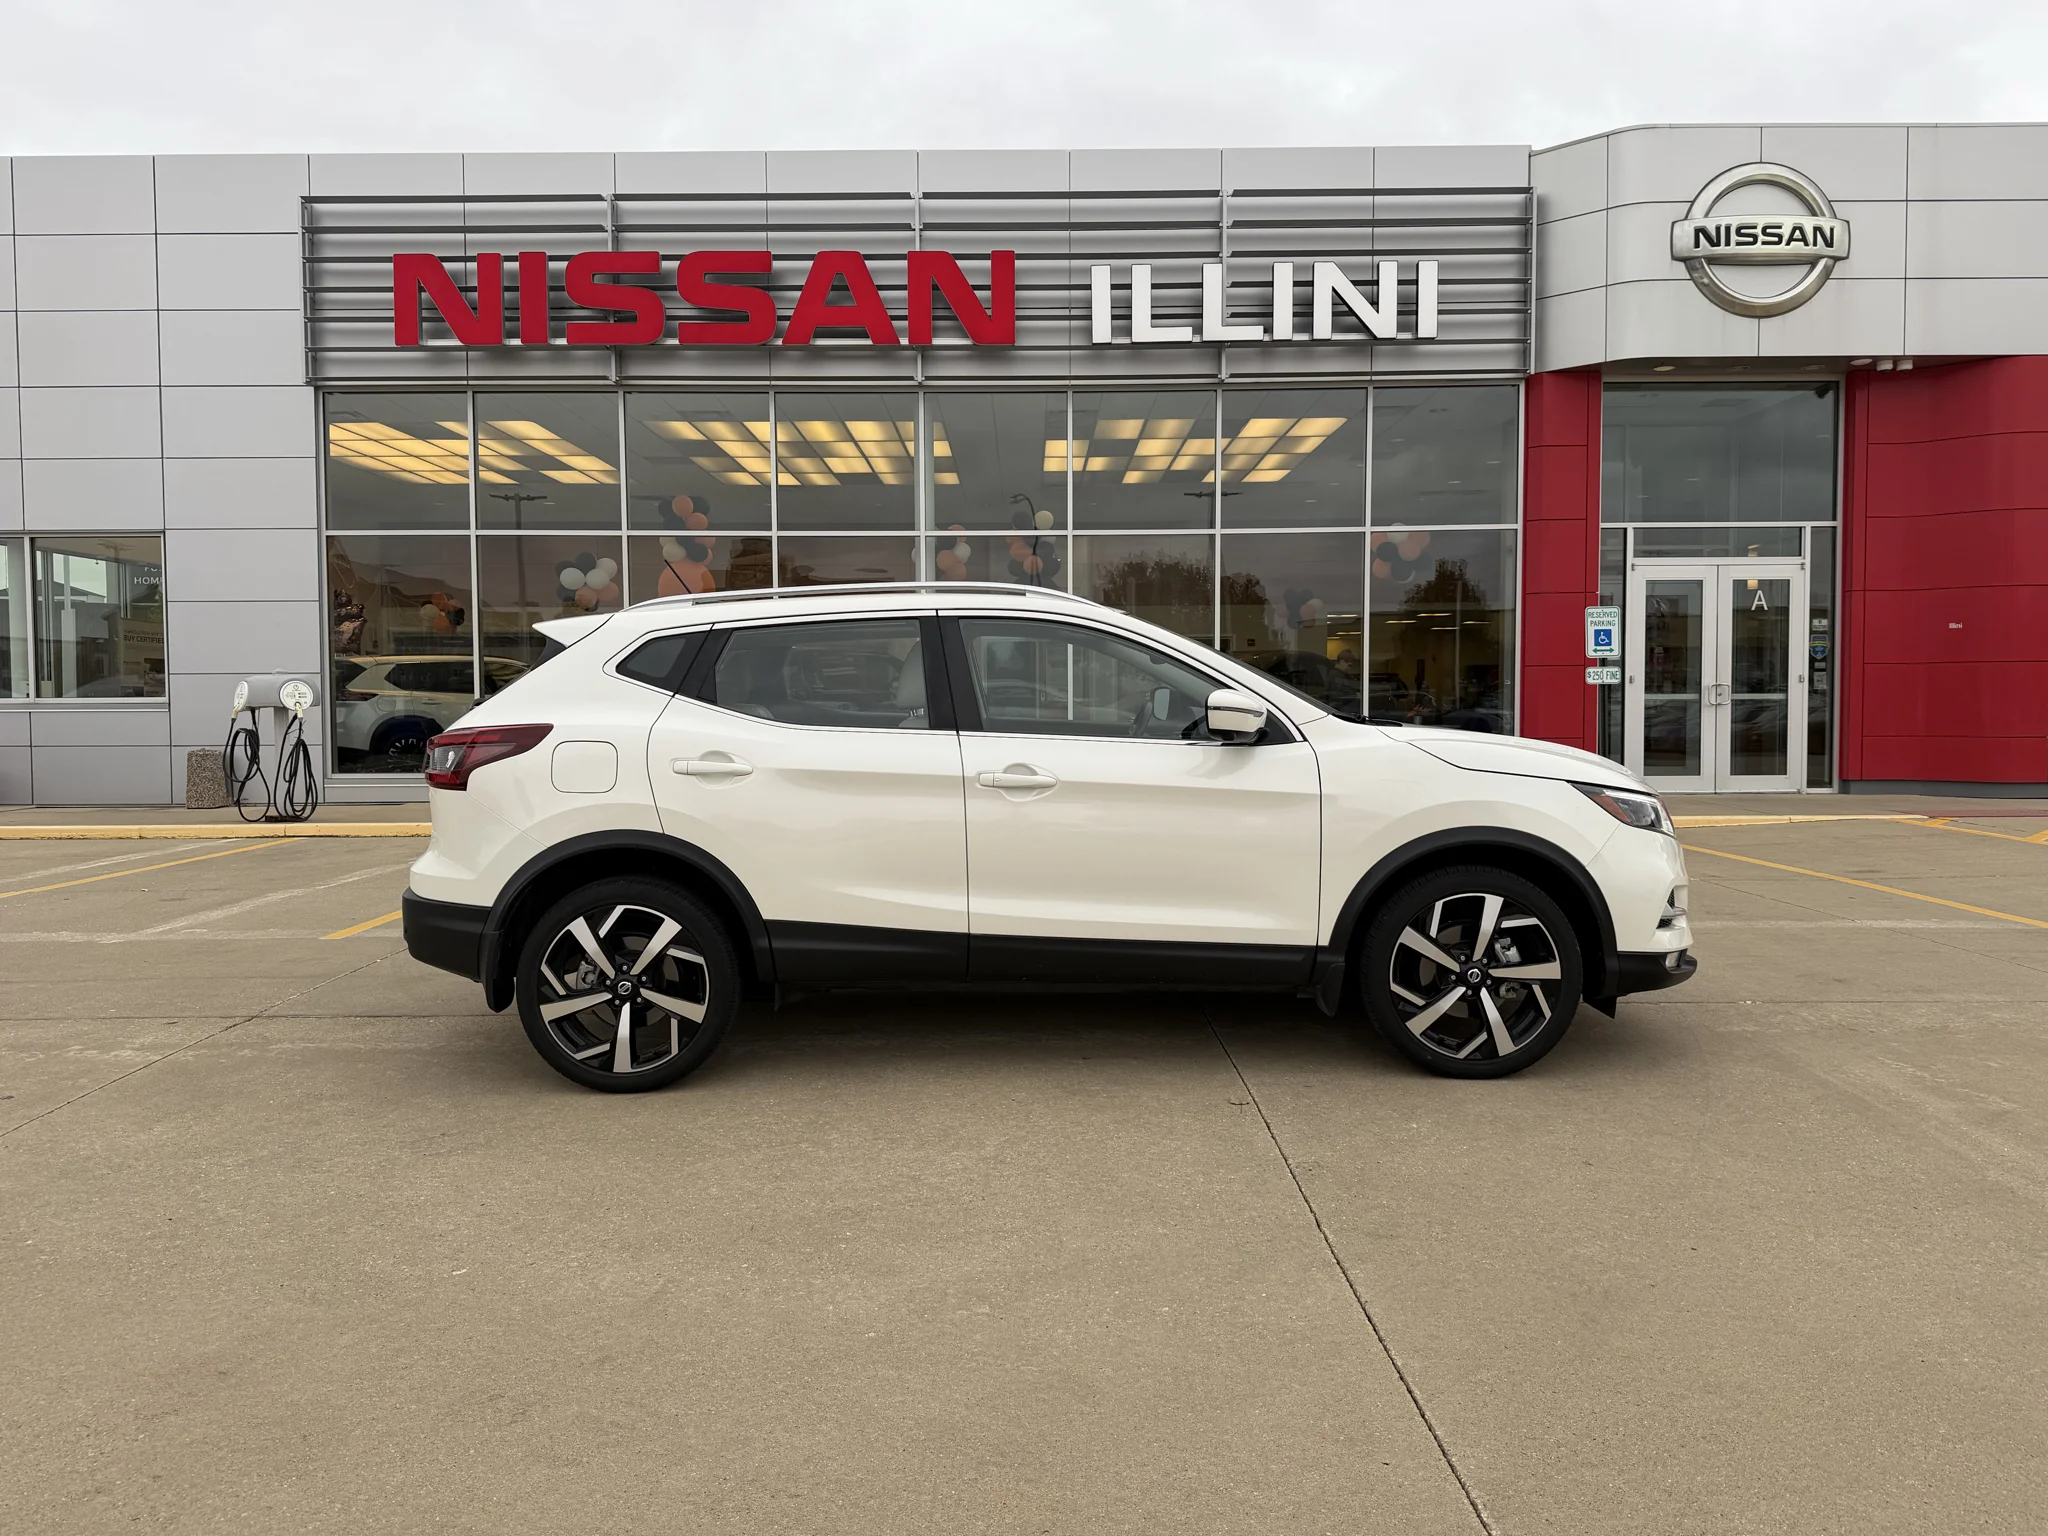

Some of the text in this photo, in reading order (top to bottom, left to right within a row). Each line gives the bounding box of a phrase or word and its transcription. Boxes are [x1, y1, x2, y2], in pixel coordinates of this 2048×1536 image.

[1694, 223, 1835, 249] NISSAN
[393, 250, 1439, 346] NISSAN ILLINI
[1751, 590, 1769, 611] A
[1588, 611, 1618, 619] RESERVED
[1587, 670, 1620, 681] $250 FINE
